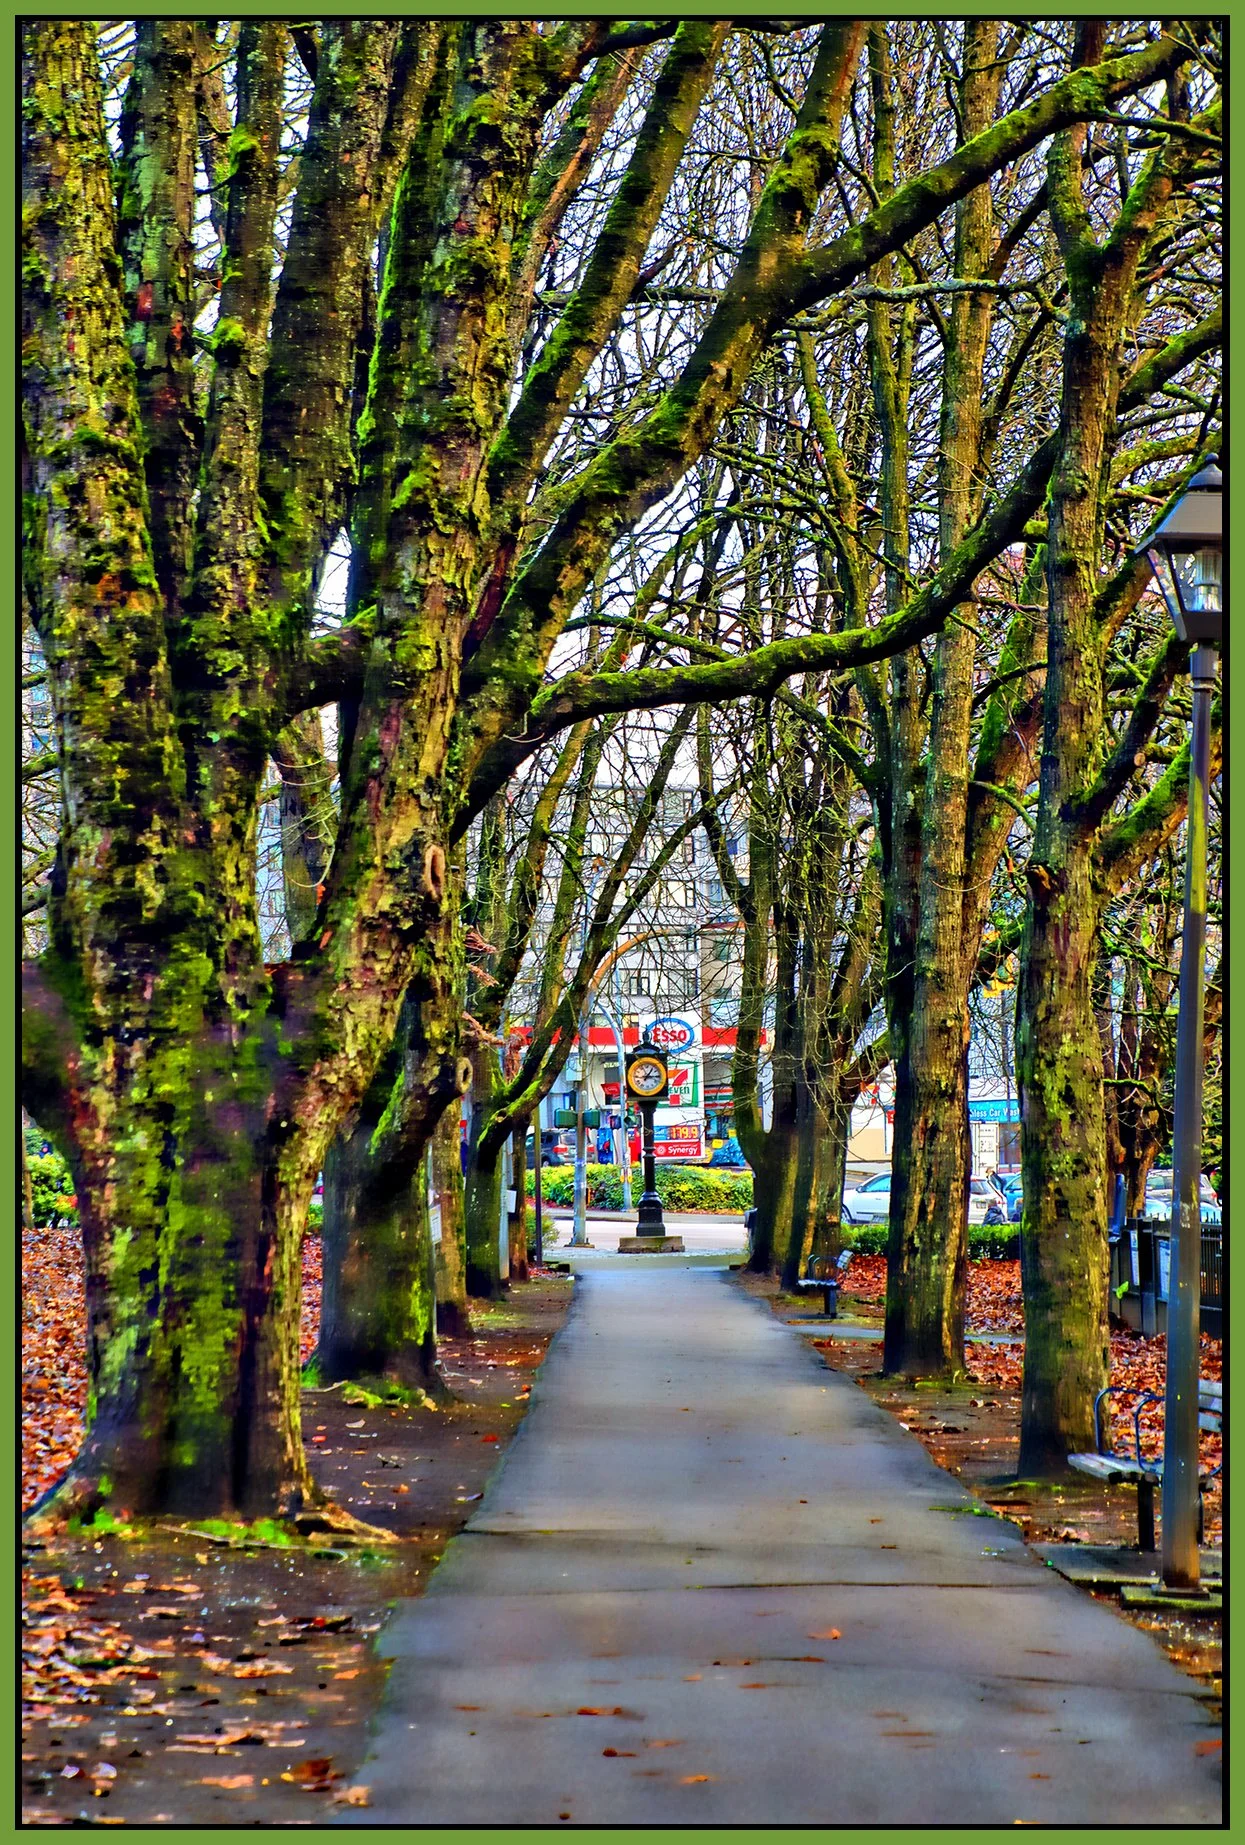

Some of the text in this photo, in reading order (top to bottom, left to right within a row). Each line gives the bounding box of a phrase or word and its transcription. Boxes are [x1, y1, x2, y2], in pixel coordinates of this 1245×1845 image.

[989, 1108, 1000, 1117] Car
[671, 1126, 698, 1139] 179.9
[668, 1146, 698, 1155] Synergy
